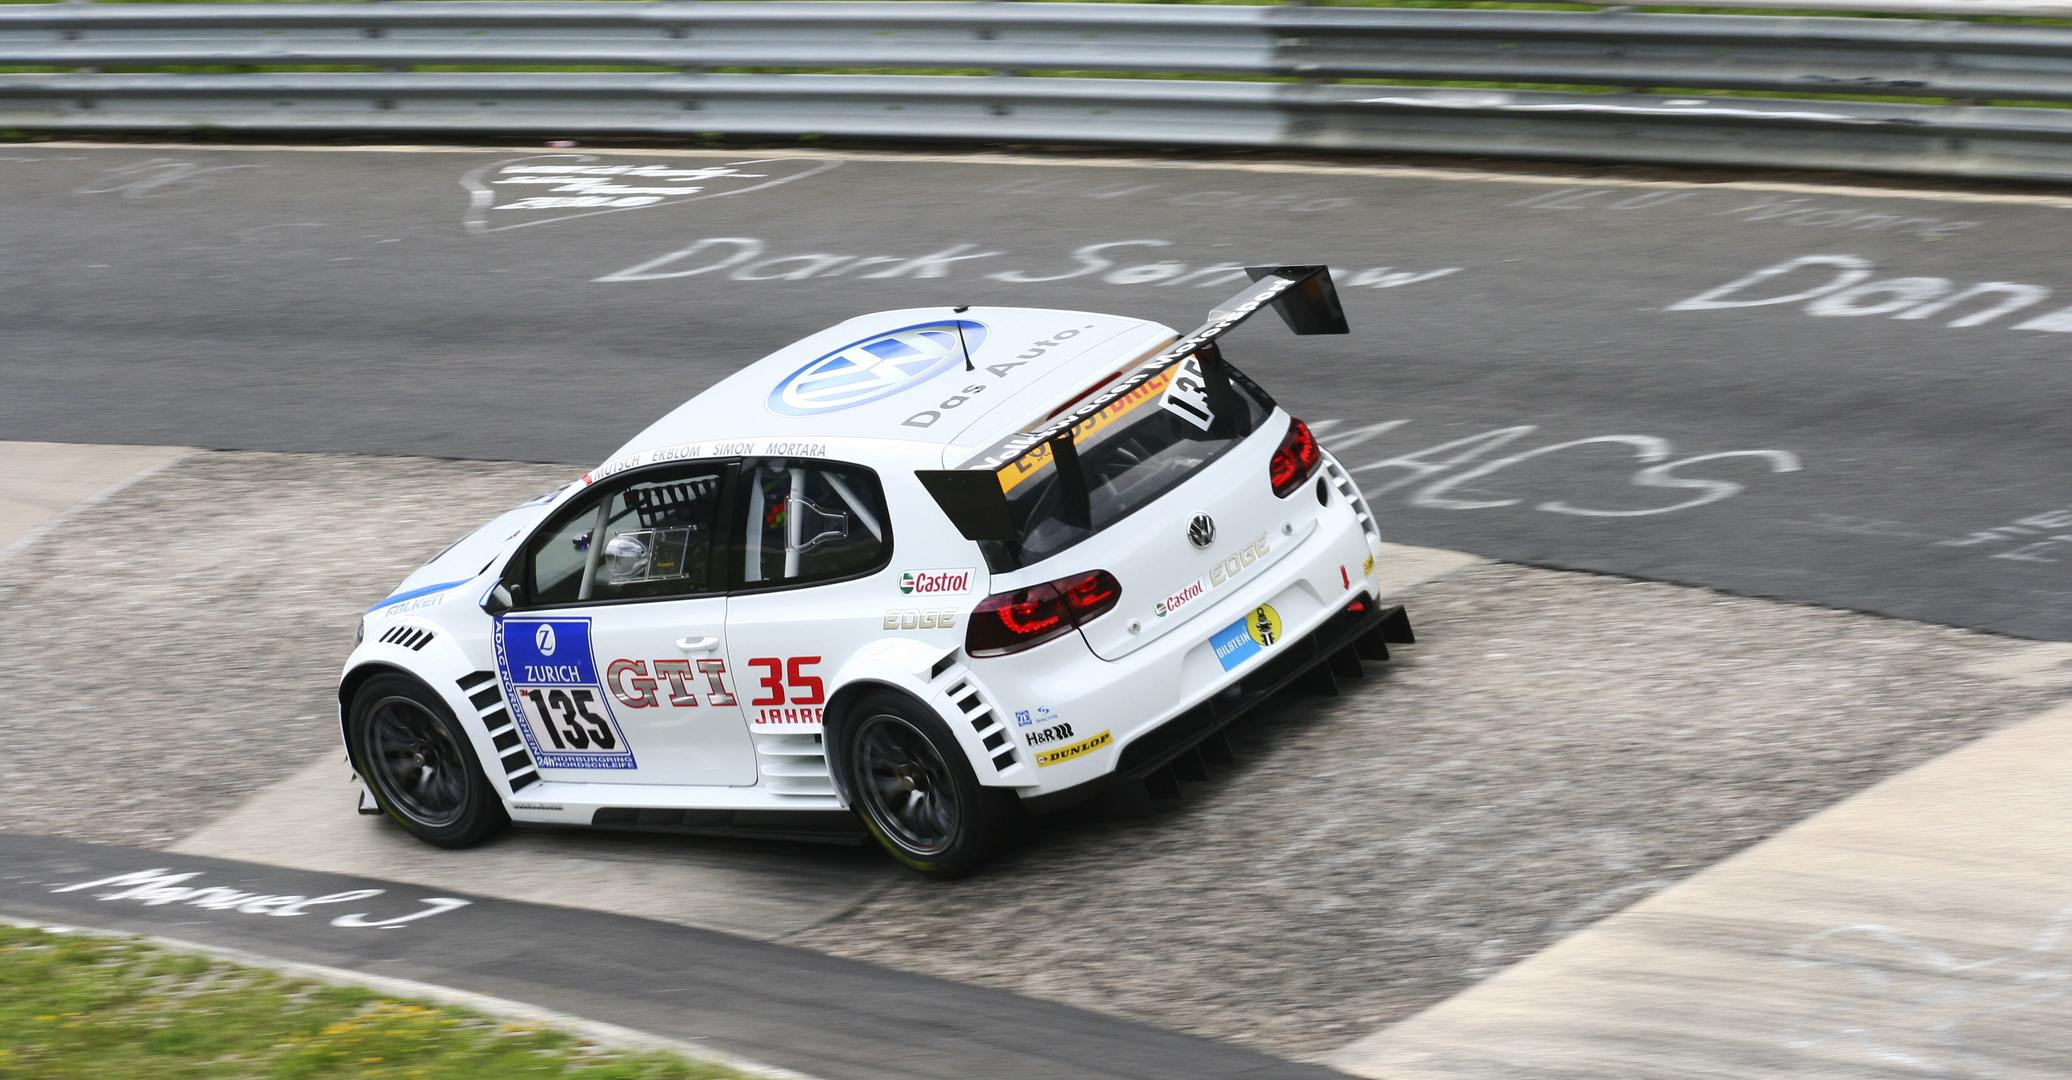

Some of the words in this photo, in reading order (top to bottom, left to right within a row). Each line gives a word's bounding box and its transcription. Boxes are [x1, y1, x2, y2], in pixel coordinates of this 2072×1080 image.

[588, 237, 1004, 283] Dark
[990, 240, 1463, 289] Sorrw
[900, 384, 987, 428] Das
[985, 324, 1094, 378] Auto.
[969, 372, 1149, 471] Volkswagen
[1142, 279, 1296, 370] Motorsport
[652, 445, 701, 462] EKBLOM
[712, 442, 755, 456] SIMON
[766, 442, 827, 457] MORTARA
[915, 571, 969, 593] Castrol
[1166, 580, 1204, 613] Castrol
[1209, 531, 1271, 588] EDGE
[385, 593, 445, 618] FALKEN
[883, 606, 960, 631] EDGE
[1215, 630, 1251, 660] BILSTEIN
[495, 620, 506, 666] ADAC
[502, 670, 541, 756] NORDRHEIN
[524, 665, 582, 682] ZURICH
[606, 658, 738, 709] GTI
[747, 656, 825, 706] 35
[528, 689, 616, 750] 135
[1025, 728, 1056, 747] H&R
[537, 756, 555, 768] 24h
[1049, 733, 1110, 762] DUNLOP
[49, 867, 387, 918] Manuel
